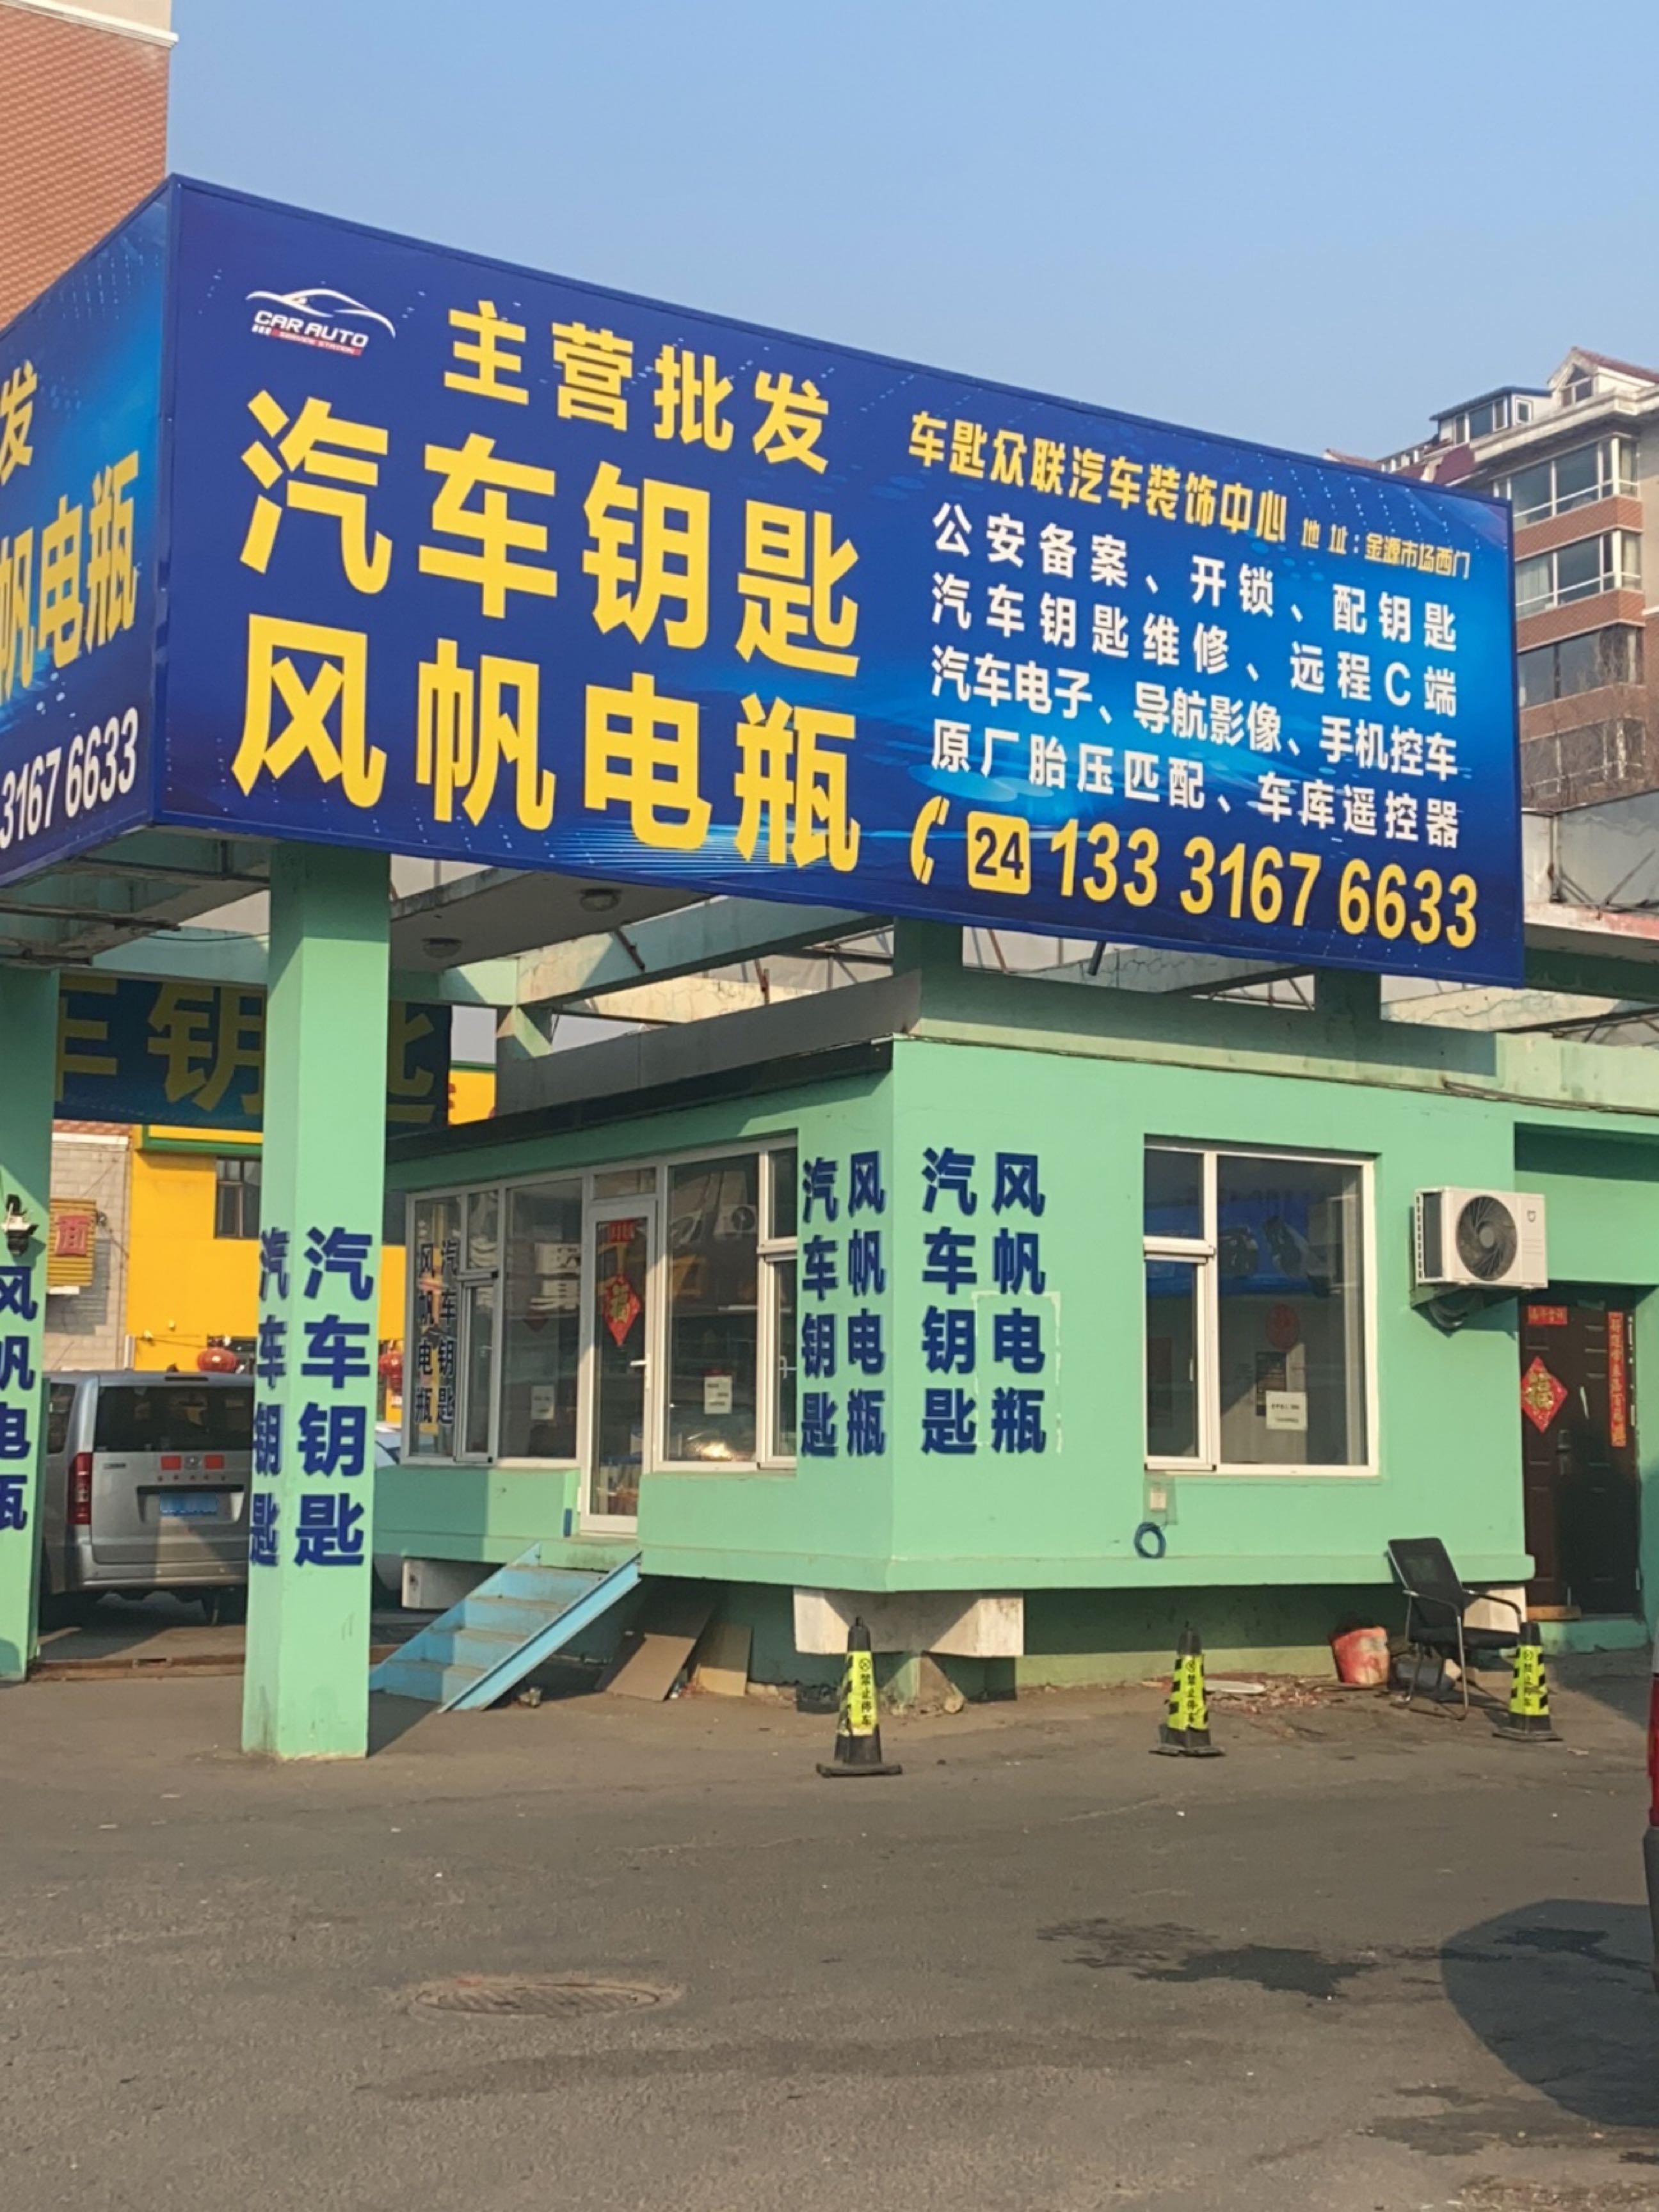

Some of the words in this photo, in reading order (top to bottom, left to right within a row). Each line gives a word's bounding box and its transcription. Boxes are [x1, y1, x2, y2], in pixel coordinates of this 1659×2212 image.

[253, 310, 304, 334] CAR
[304, 322, 369, 348] AUTO
[444, 300, 828, 474] 主营批发
[239, 390, 858, 677] 汽车钥匙
[909, 412, 1286, 541] 车匙众联汽车装饰中心
[65, 707, 138, 818] 6633
[231, 613, 860, 872] 风帆电瓶
[974, 825, 1024, 880] 24
[1050, 819, 1160, 908] 133
[1180, 835, 1322, 927] 3167
[1338, 858, 1478, 950] 6633
[249, 1226, 289, 1567] 汽车钥匙
[293, 1226, 374, 1566] 汽车钥匙
[800, 1157, 838, 1457] 汽车钥匙
[846, 1150, 886, 1457] 风帆电瓶
[920, 1146, 978, 1455] 汽车钥匙
[991, 1151, 1046, 1454] 风帆电瓶
